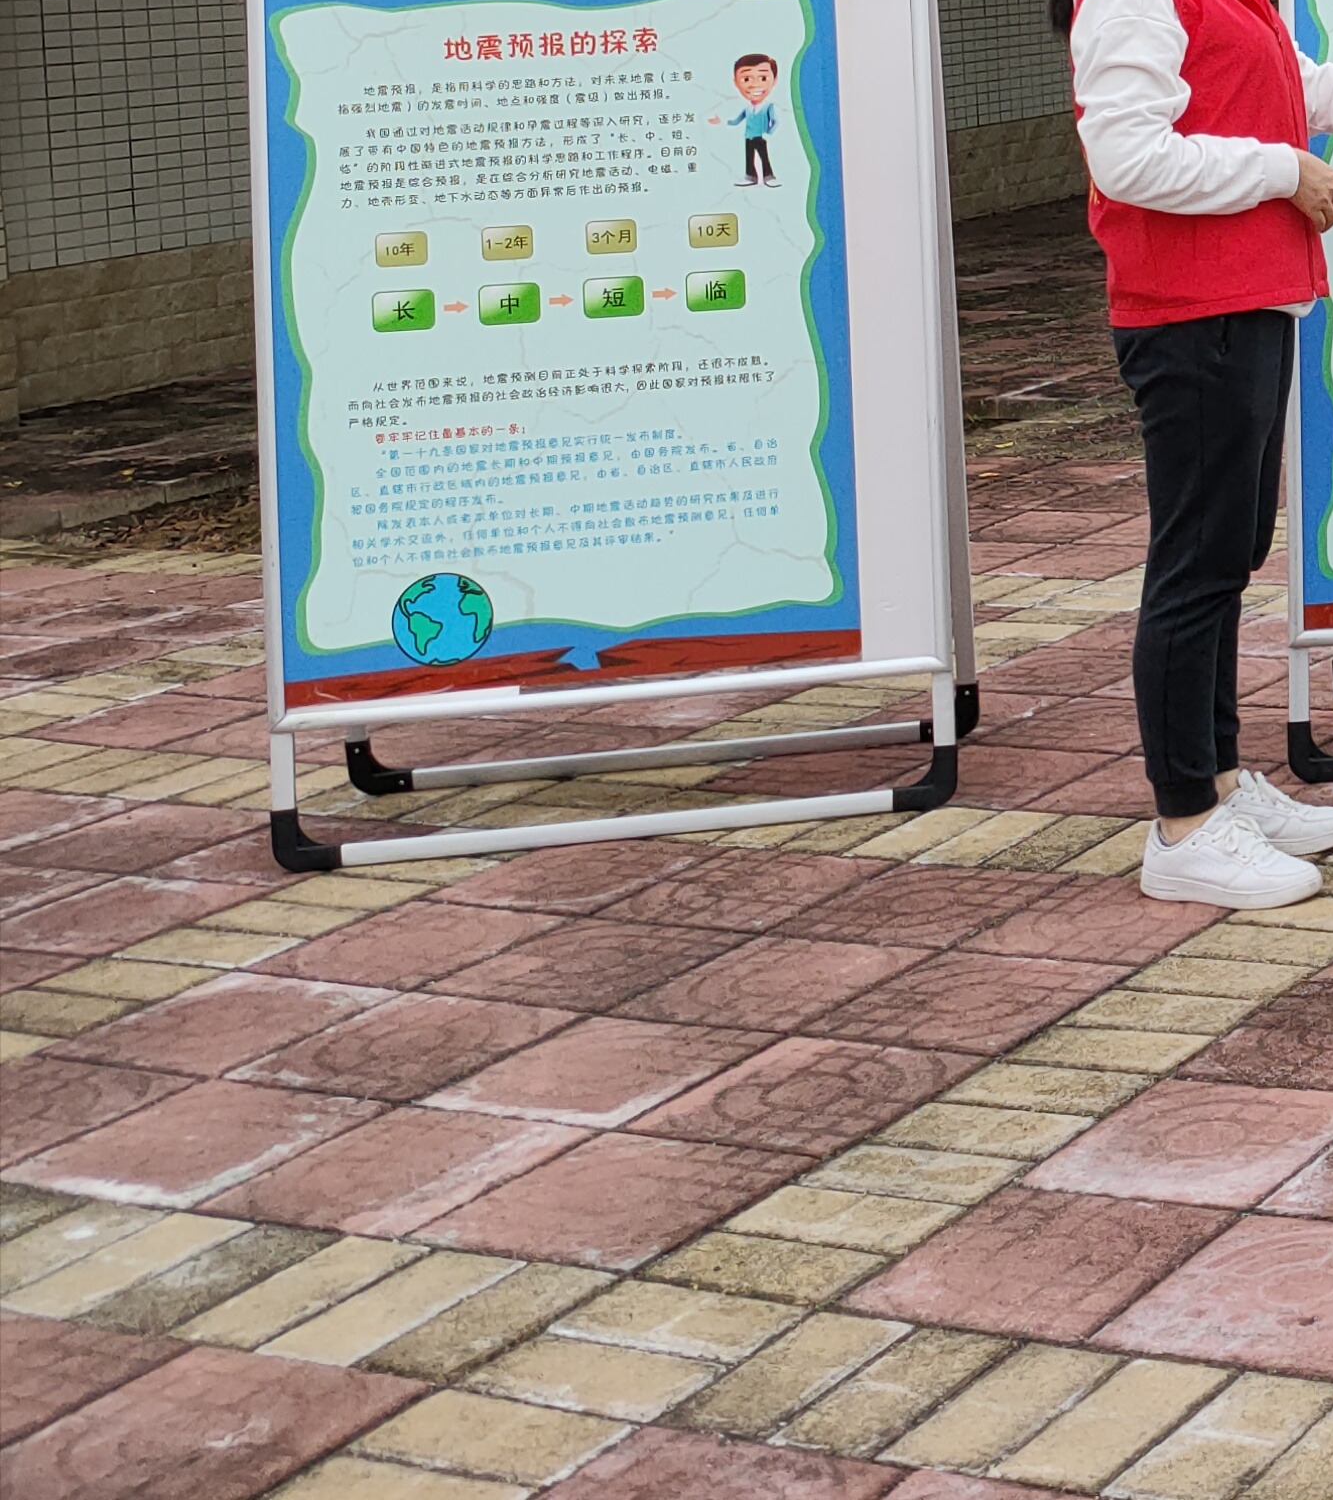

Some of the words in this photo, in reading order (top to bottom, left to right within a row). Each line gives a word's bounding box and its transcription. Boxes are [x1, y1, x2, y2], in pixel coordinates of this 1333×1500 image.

[444, 28, 659, 61] 地震预报的探索
[592, 227, 633, 245] 3个月
[697, 222, 732, 238] 10天
[384, 241, 416, 258] 10年
[486, 234, 529, 253] 1-2年
[602, 288, 627, 309] 短
[705, 280, 727, 302] 临
[393, 300, 417, 322] 长
[500, 294, 521, 315] 中
[348, 414, 410, 430] 严格规定。
